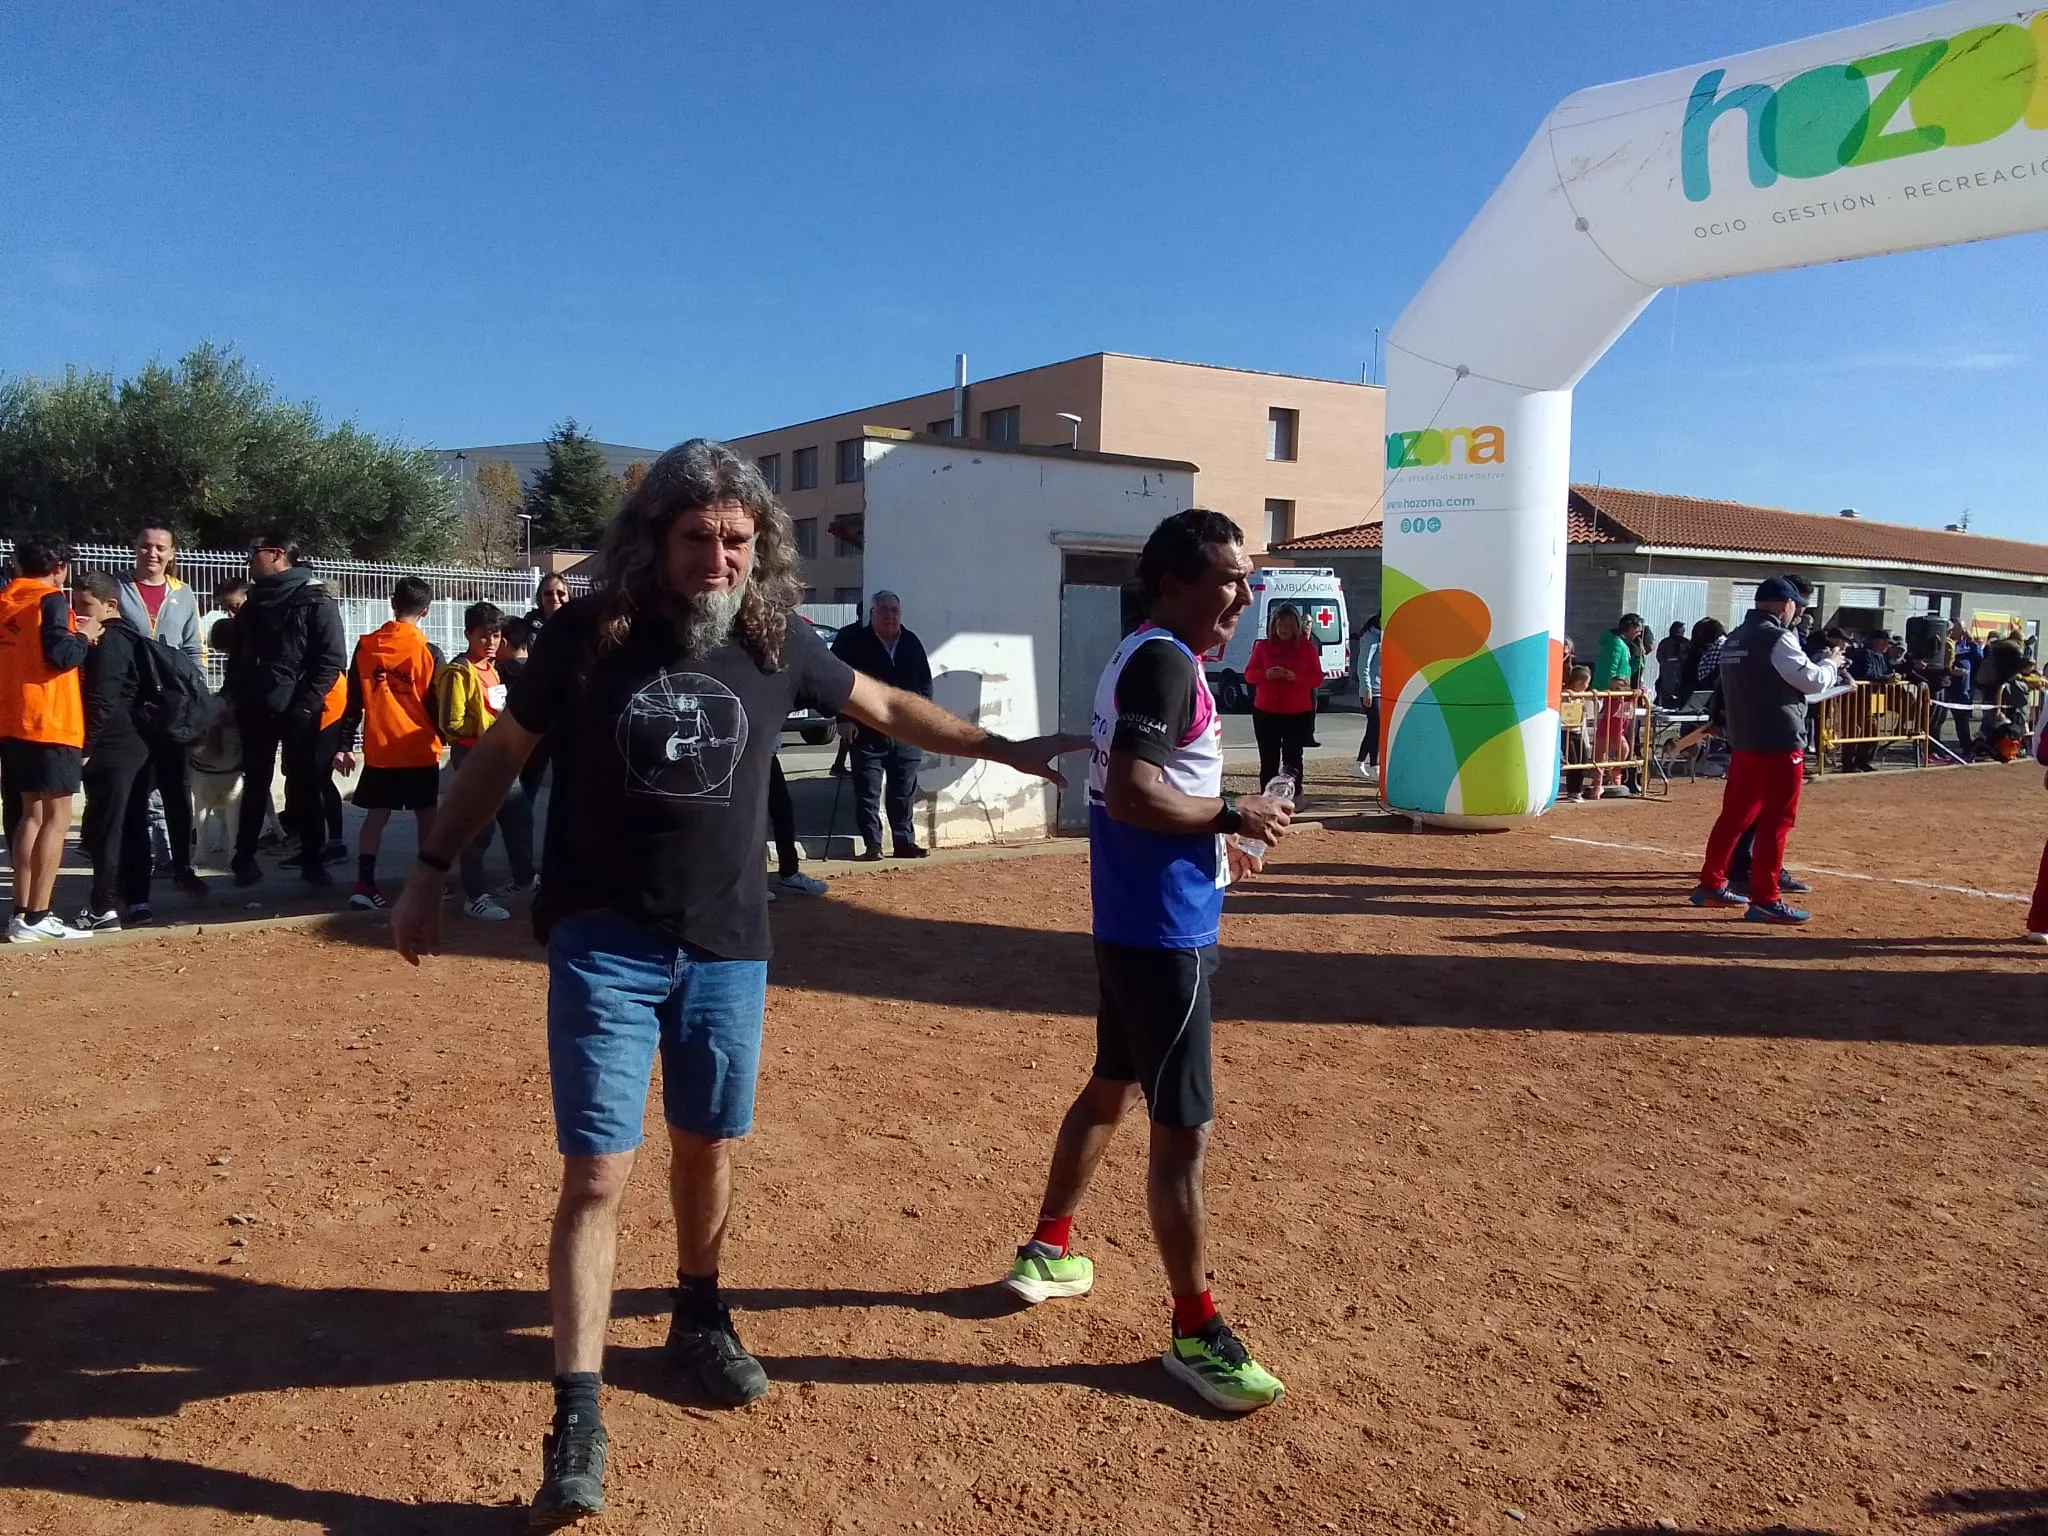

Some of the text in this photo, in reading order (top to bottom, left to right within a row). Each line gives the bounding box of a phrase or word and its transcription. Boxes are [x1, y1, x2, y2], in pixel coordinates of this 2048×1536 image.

[1681, 10, 2048, 202] hozo
[1694, 218, 1747, 239] OCIO
[1772, 193, 1876, 225] GESTIÓN
[1274, 583, 1334, 592] AMBULANCIA
